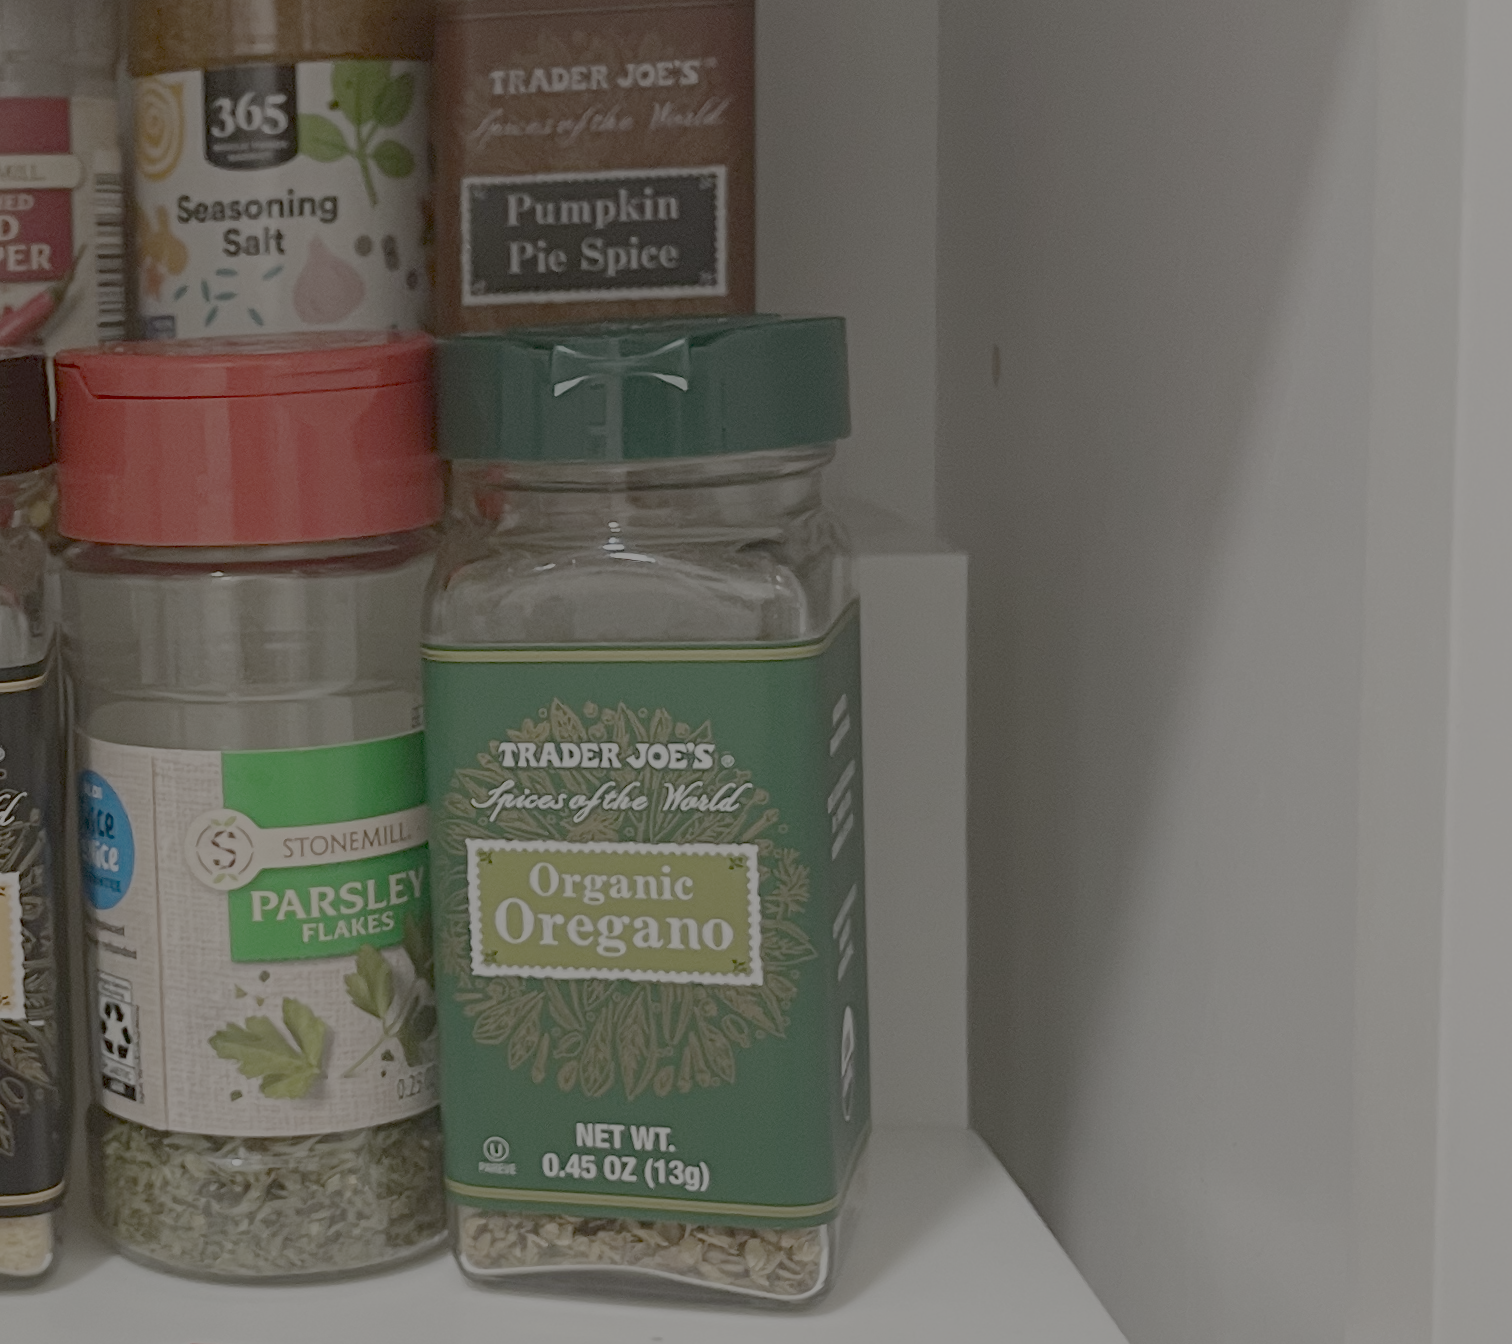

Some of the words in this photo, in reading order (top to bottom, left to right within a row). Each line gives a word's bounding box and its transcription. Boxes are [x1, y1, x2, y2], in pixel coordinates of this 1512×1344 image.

[490, 65, 609, 95] TRADER
[617, 60, 701, 88] JOE'S
[210, 92, 288, 138] 365
[177, 189, 338, 225] Seasoning
[506, 189, 680, 229] Pumpkin
[222, 227, 285, 257] Salt
[508, 239, 567, 275] Pie
[580, 235, 680, 279] Spice
[498, 741, 621, 770] TRADER
[627, 742, 715, 771] JOE'S
[471, 780, 565, 822] Spices
[662, 782, 753, 813] World
[282, 822, 409, 859] STONEMILL
[251, 868, 425, 922] PARSLEY
[529, 862, 694, 904] Organic
[302, 911, 395, 943] FLAKES
[495, 898, 735, 956] Oregano
[576, 1122, 628, 1150] NET
[632, 1126, 676, 1154] WT.
[542, 1152, 599, 1182] 0.45
[604, 1156, 640, 1184] OZ
[644, 1159, 710, 1192] (13g)
